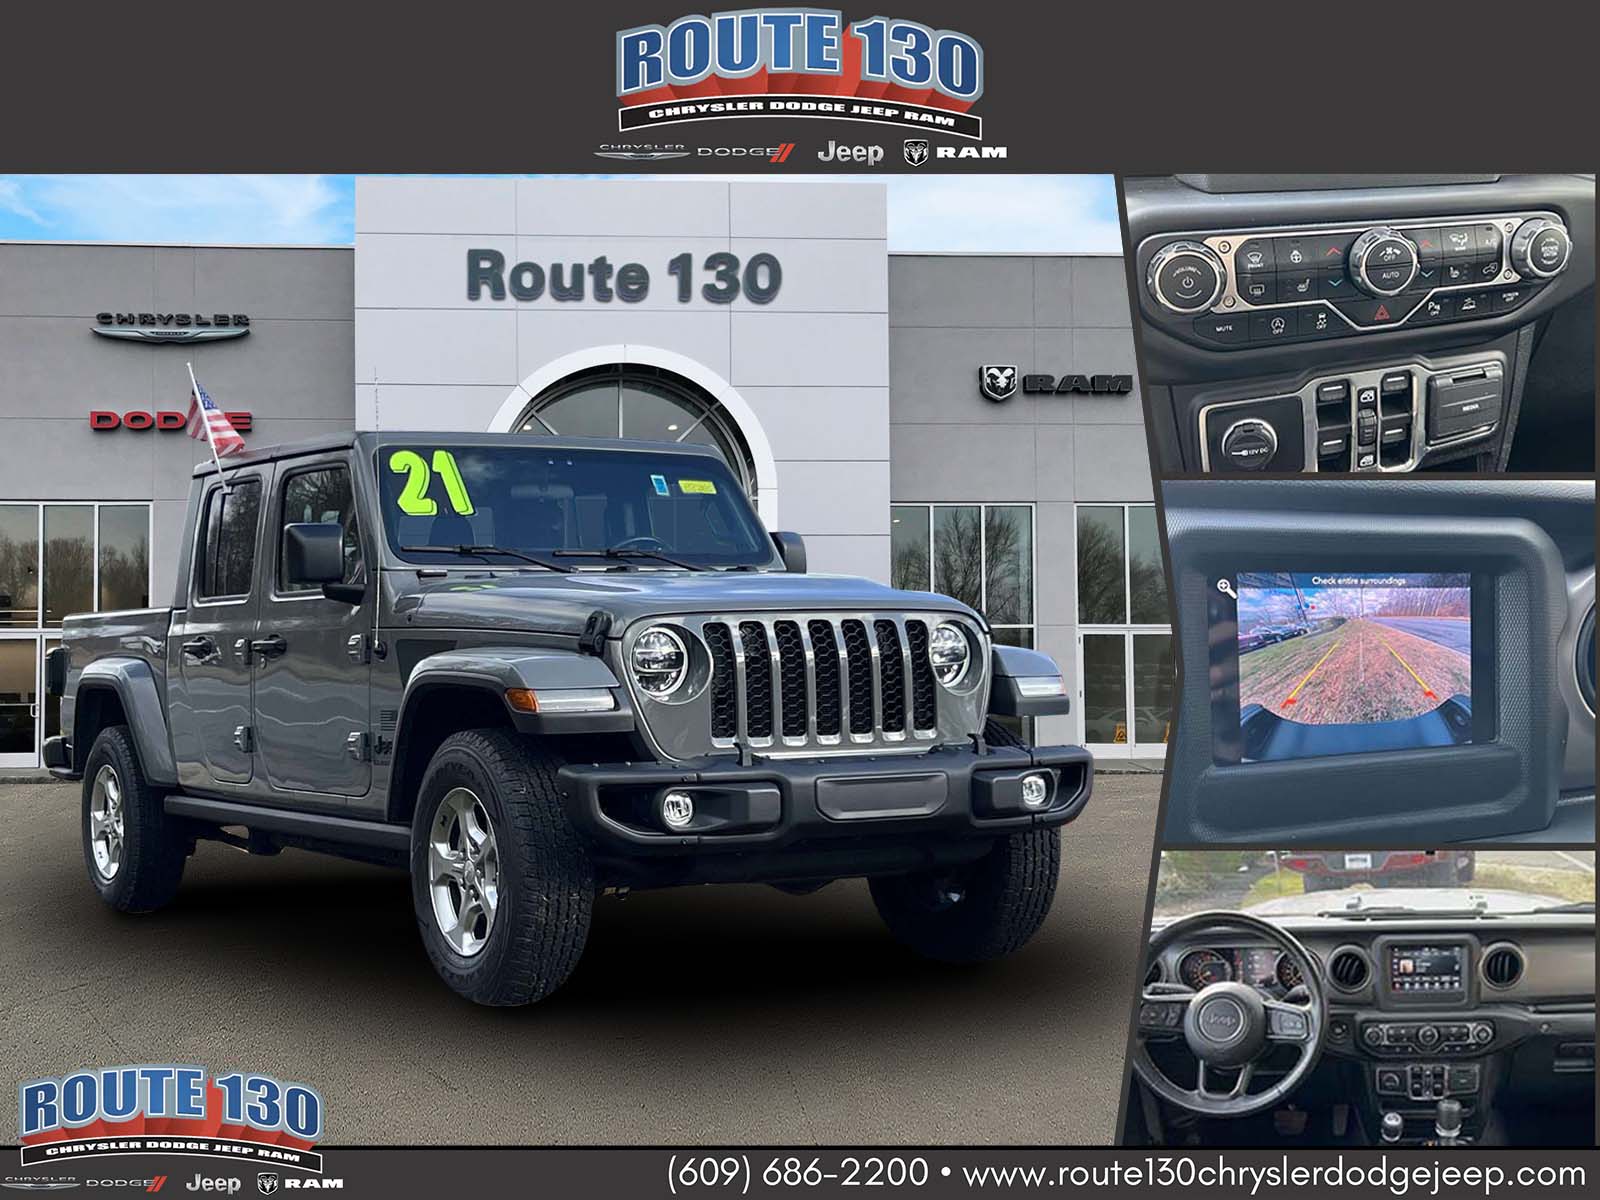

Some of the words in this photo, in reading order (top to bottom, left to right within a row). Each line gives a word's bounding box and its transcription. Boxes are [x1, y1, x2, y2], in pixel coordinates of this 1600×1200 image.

[467, 248, 650, 303] Route
[668, 251, 783, 305] 130
[1382, 271, 1400, 279] AUTO
[96, 312, 250, 326] CHRYSLER
[1023, 374, 1133, 394] RAM
[89, 411, 252, 431] DODE
[389, 449, 475, 516] 21
[1312, 576, 1337, 585] Check
[1338, 576, 1359, 585] entire
[1360, 576, 1406, 587] surroundings
